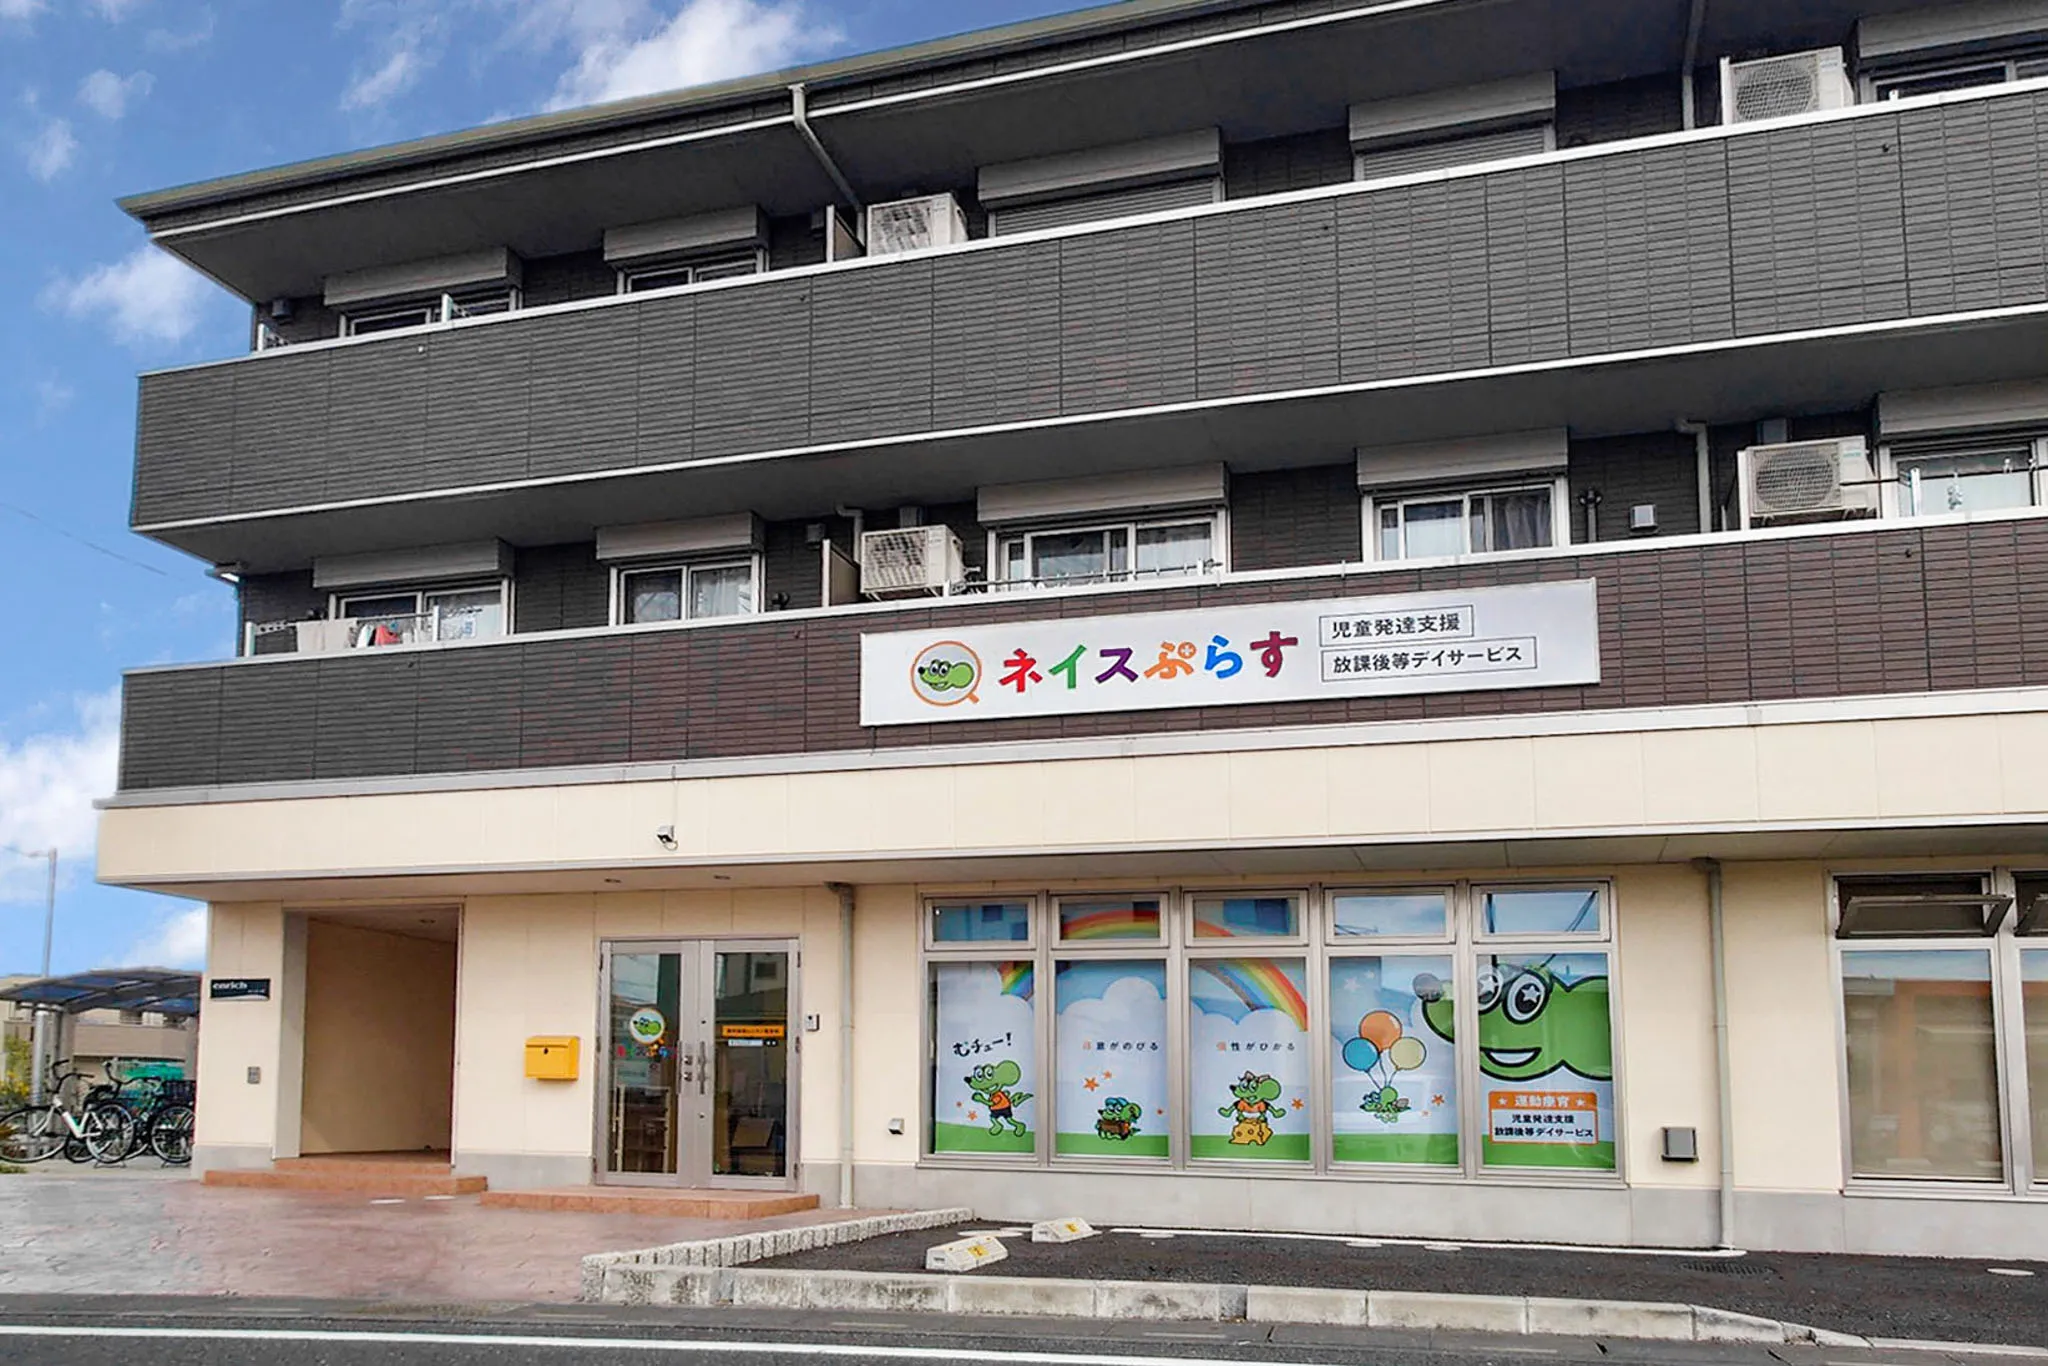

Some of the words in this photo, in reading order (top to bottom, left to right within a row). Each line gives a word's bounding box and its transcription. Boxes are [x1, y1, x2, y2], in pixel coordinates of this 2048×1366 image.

[1332, 612, 1461, 639] 児童発達支援
[999, 631, 1299, 693] ネイスぷらす
[1333, 646, 1523, 674] 放課後等デイサービス
